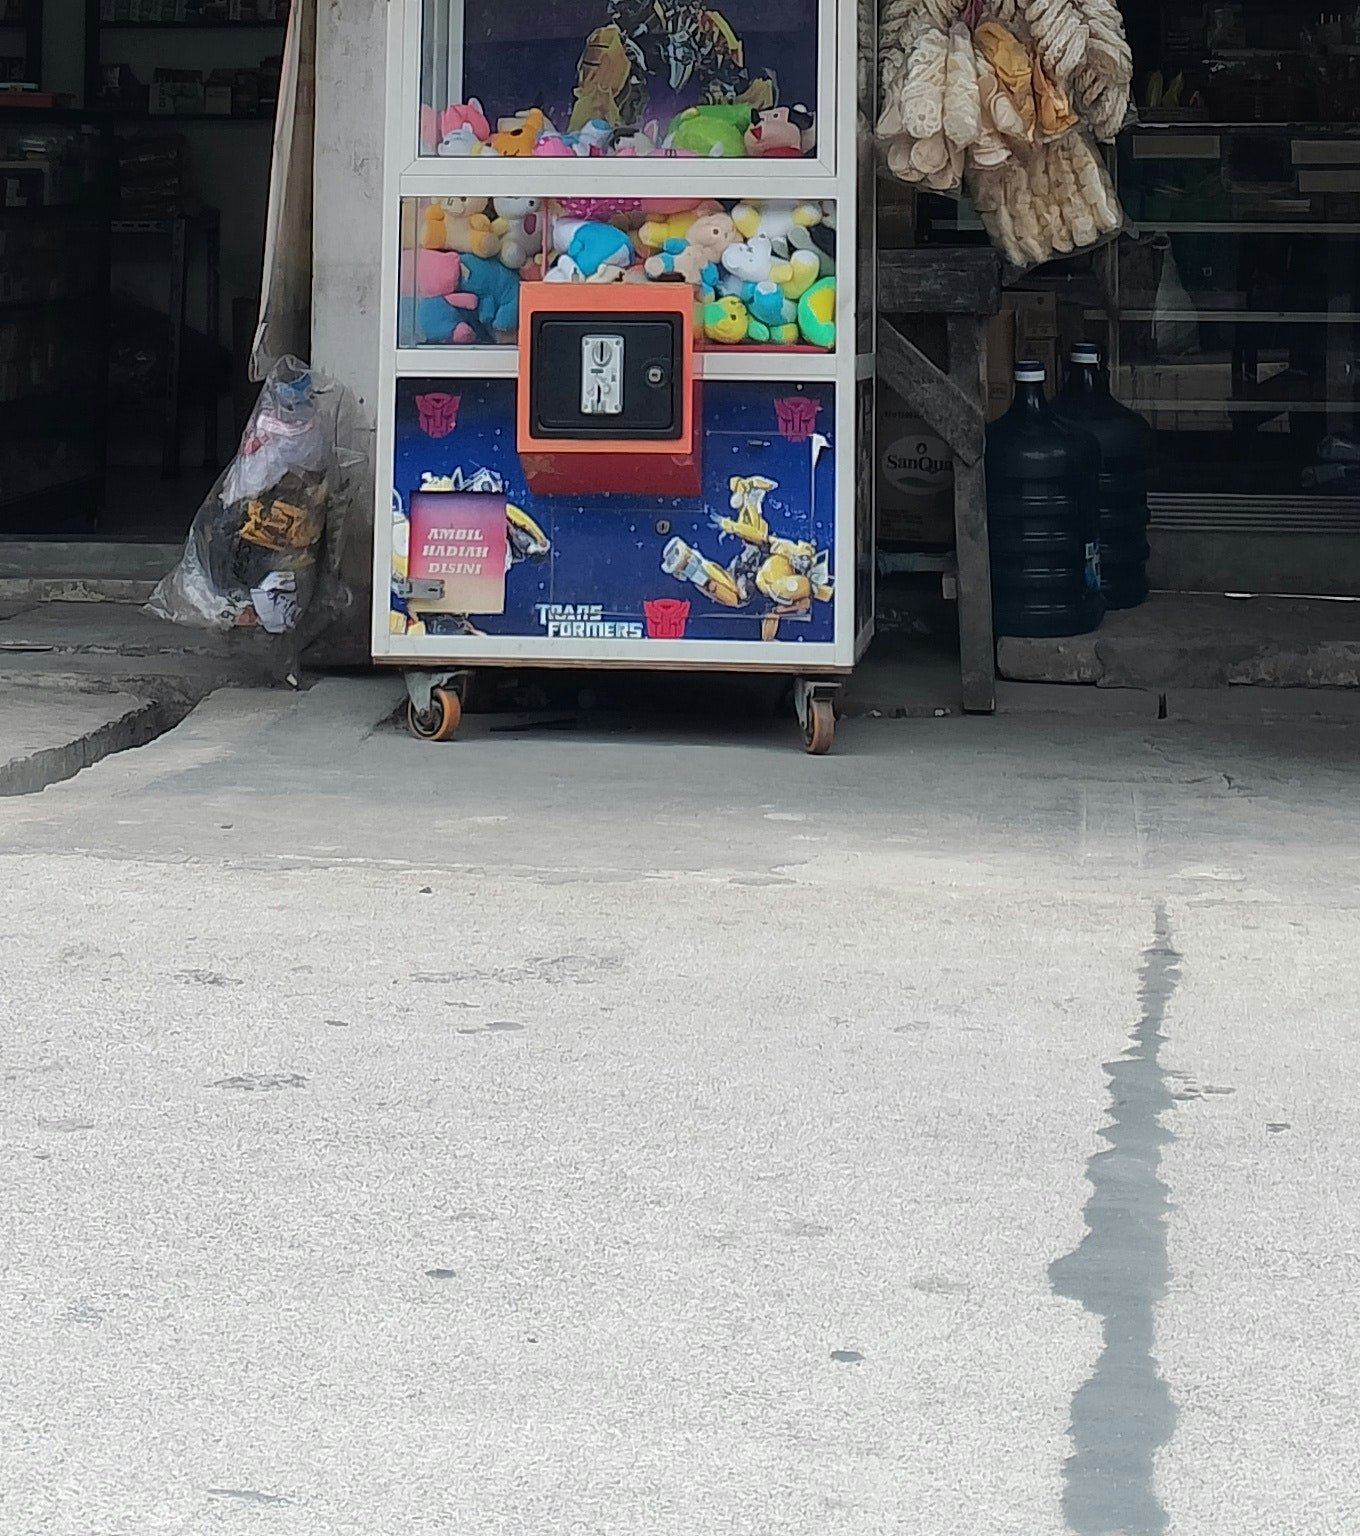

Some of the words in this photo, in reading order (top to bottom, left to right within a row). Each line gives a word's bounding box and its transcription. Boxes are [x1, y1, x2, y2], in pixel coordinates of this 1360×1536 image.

[427, 527, 484, 541] AMBIL
[422, 545, 490, 558] HADIAH
[427, 562, 482, 575] DISINI
[535, 603, 605, 626] TRANS
[548, 620, 644, 640] FORMERS
